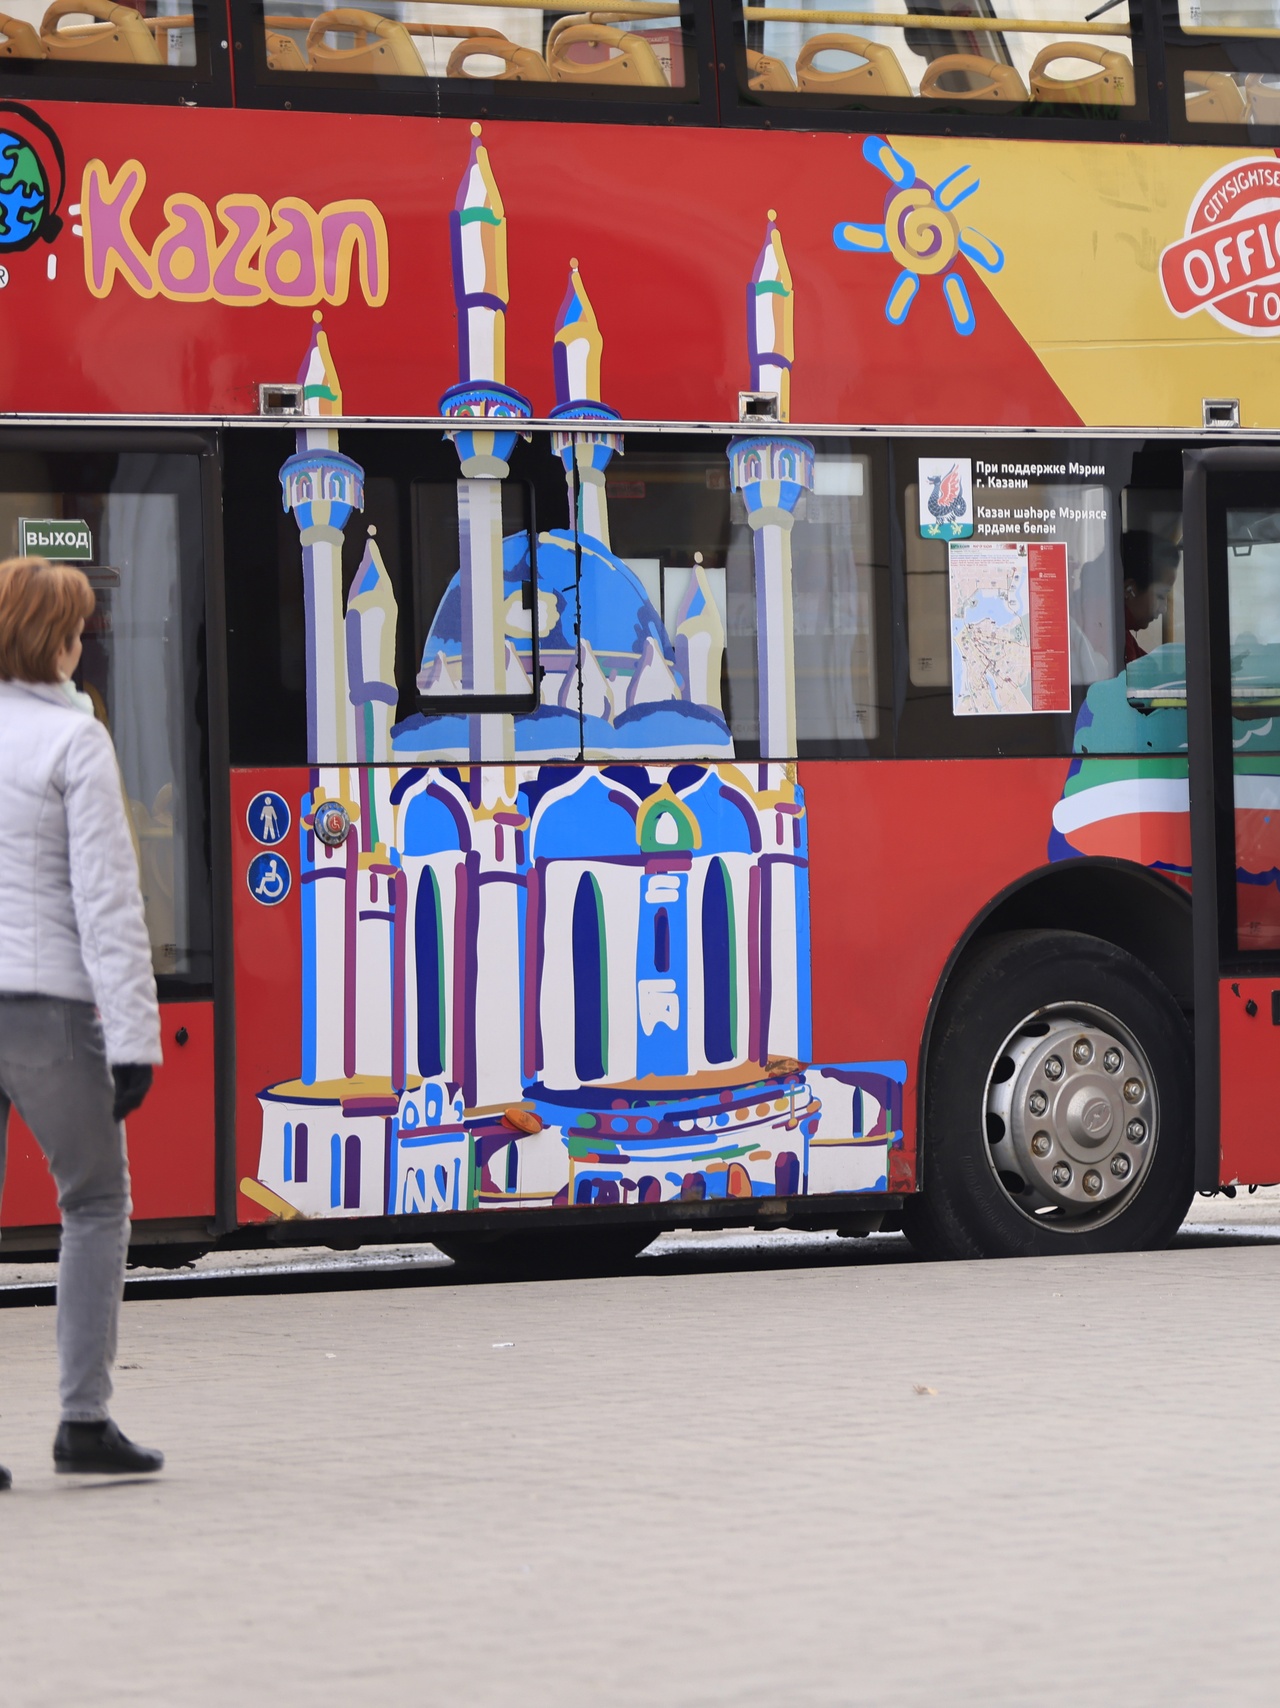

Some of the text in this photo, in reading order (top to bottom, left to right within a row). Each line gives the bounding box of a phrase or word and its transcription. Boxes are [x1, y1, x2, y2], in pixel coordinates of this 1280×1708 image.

[80, 158, 389, 307] Kazan
[976, 461, 1105, 477] При поддержке Мэрии
[976, 476, 1028, 489] г. Казани
[977, 506, 1107, 521] Казан шәһәре Мэриясе
[977, 521, 1056, 536] ярдәме белән
[26, 532, 88, 549] ВЫХОД
